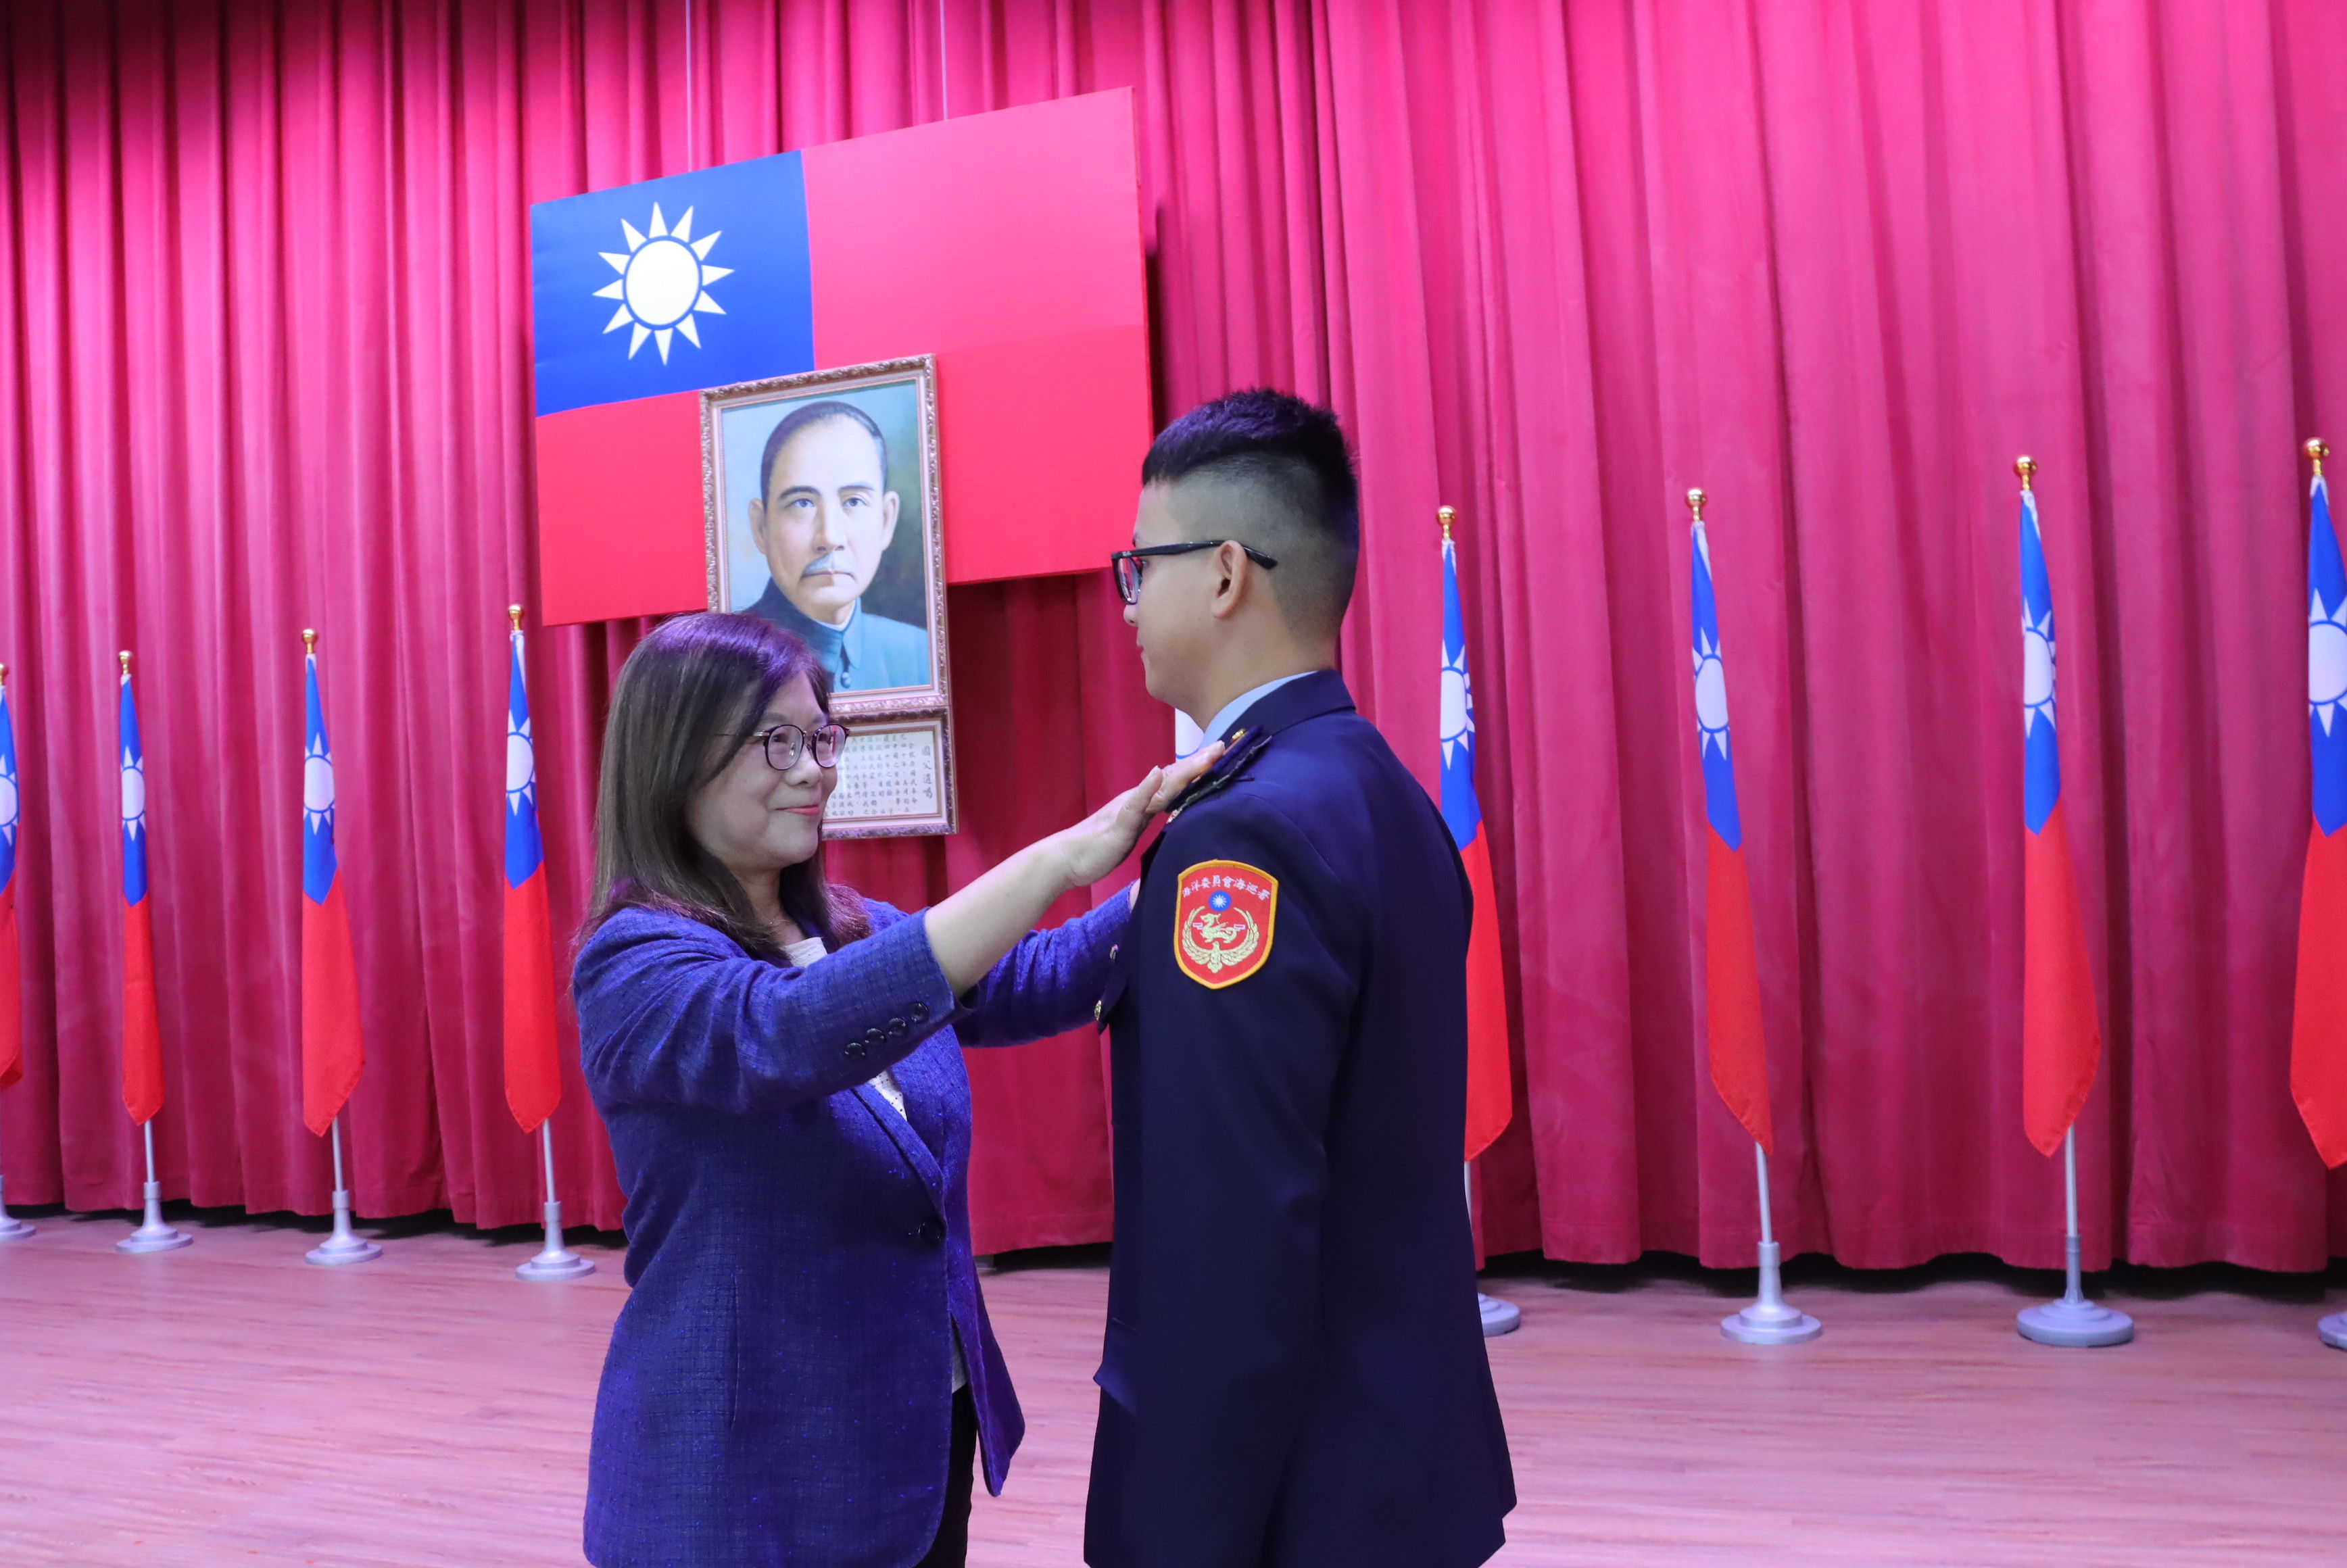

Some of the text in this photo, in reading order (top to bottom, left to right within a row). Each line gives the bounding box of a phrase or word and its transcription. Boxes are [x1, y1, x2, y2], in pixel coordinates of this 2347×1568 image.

[1182, 875, 1271, 901] 海洋委員會海巡署
